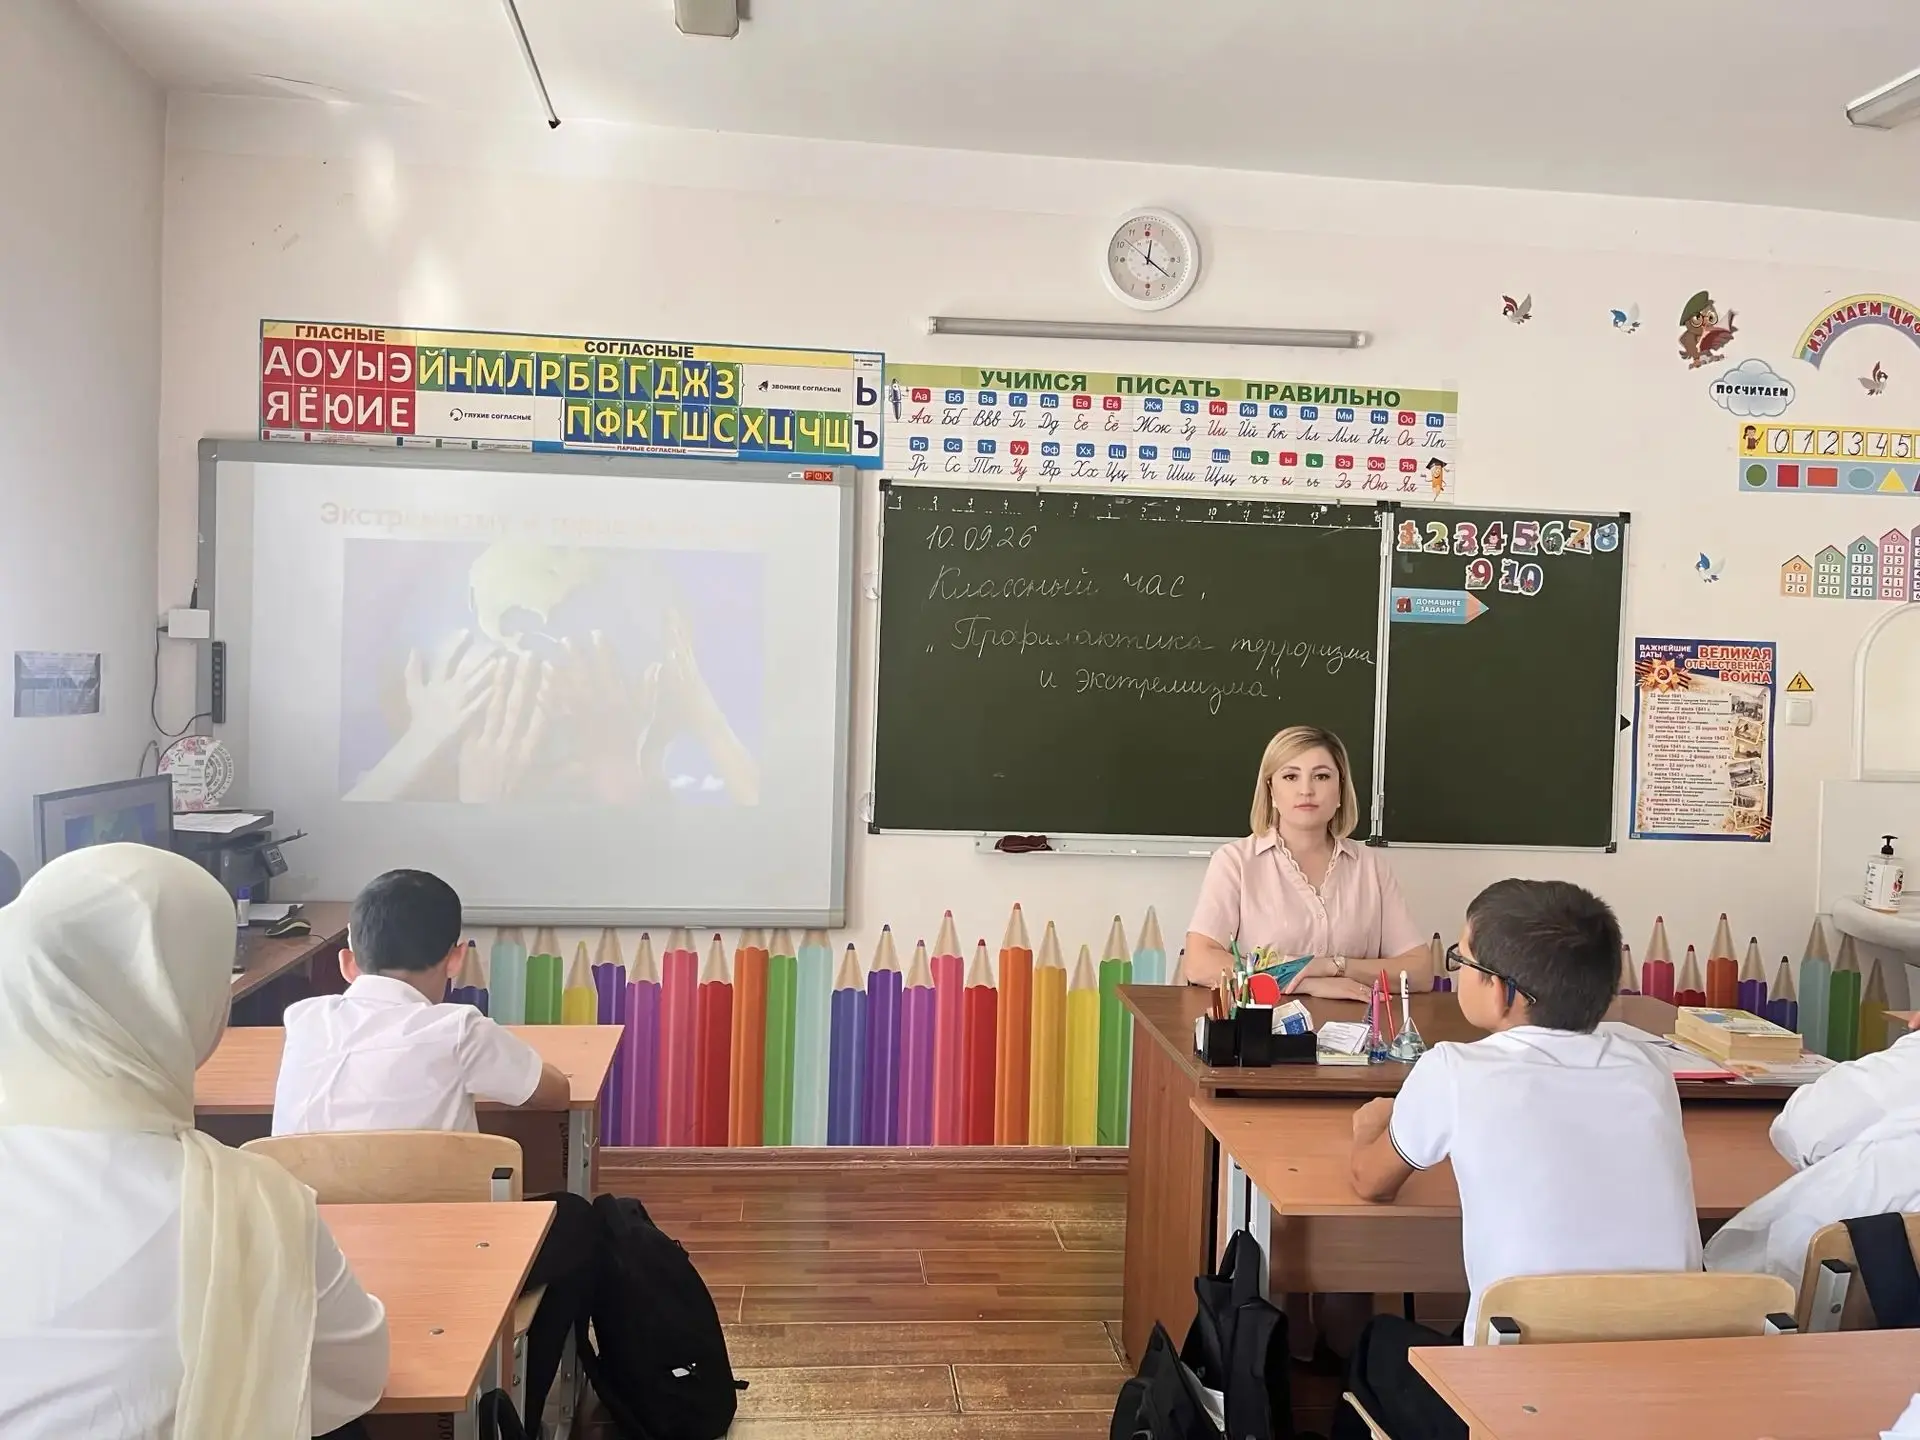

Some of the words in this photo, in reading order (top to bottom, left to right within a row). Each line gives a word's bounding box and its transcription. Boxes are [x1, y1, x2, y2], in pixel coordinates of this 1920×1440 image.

[295, 325, 385, 342] ГЛАСНЫЕ
[1806, 302, 1882, 353] ИЗУЧАЕМ
[584, 341, 694, 358] СОГЛАСНЫЕ
[264, 346, 292, 377] А
[296, 348, 322, 378] О
[328, 349, 352, 379] У
[357, 351, 384, 381] Ы
[390, 352, 412, 383] Э
[419, 349, 443, 385] Й
[449, 356, 472, 386] Н
[476, 356, 504, 387] М
[507, 358, 533, 389] Л
[540, 360, 561, 390] Р
[569, 361, 590, 391] Б
[598, 363, 620, 393] В
[630, 365, 646, 394] Г
[655, 366, 679, 400] Д
[683, 367, 709, 398] Ж
[715, 369, 734, 399] З
[857, 377, 878, 406] Ь
[980, 370, 1086, 391] УЧИМСЯ
[1117, 376, 1221, 397] ПИСАТЬ
[1247, 383, 1400, 407] ПРАВИЛЬНО
[1716, 384, 1789, 397] ПОСЧИТАЕМ
[266, 391, 289, 421] Я
[300, 386, 318, 423] Ё
[325, 393, 354, 424] Ю
[357, 395, 382, 426] И
[391, 397, 409, 427] Е
[567, 405, 591, 435] П
[596, 407, 621, 437] Ф
[627, 409, 648, 438] К
[656, 410, 678, 439] Т
[682, 411, 708, 441] Ш
[713, 413, 735, 442] С
[741, 414, 764, 443] Х
[769, 416, 792, 450] Ц
[800, 417, 821, 446] Ч
[825, 418, 850, 452] Щ
[854, 420, 878, 449] Ъ
[1775, 429, 1790, 453] 0
[1804, 430, 1815, 454] 1
[1824, 431, 1839, 455] 2
[1848, 432, 1864, 456] 3
[1876, 432, 1888, 457] 4
[1895, 434, 1912, 458] 5
[926, 524, 1038, 551] 10.09.26
[1398, 520, 1422, 551] 1
[1424, 522, 1449, 554] 2
[1454, 522, 1478, 555] 3
[1481, 521, 1507, 555] 4
[1511, 521, 1539, 555] 5
[1540, 521, 1564, 554] 6
[1565, 520, 1592, 554] 7
[1595, 522, 1618, 551] 8
[928, 565, 1099, 600] Классный
[1466, 558, 1493, 589] 9
[1499, 559, 1543, 596] 10
[1416, 599, 1461, 607] ДОМАШНЕЕ
[1420, 606, 1456, 614] ЗАДАНИЕ
[1231, 636, 1376, 674] терроризма
[1640, 644, 1692, 652] ВАЖНЕЙШИЕ
[1699, 646, 1771, 660] ВЕЛИКАЯ
[1685, 660, 1771, 670] ОТЕЧЕСТВЕННАЯ
[1038, 670, 1058, 688] и
[1720, 671, 1771, 683] ВОЙНА
